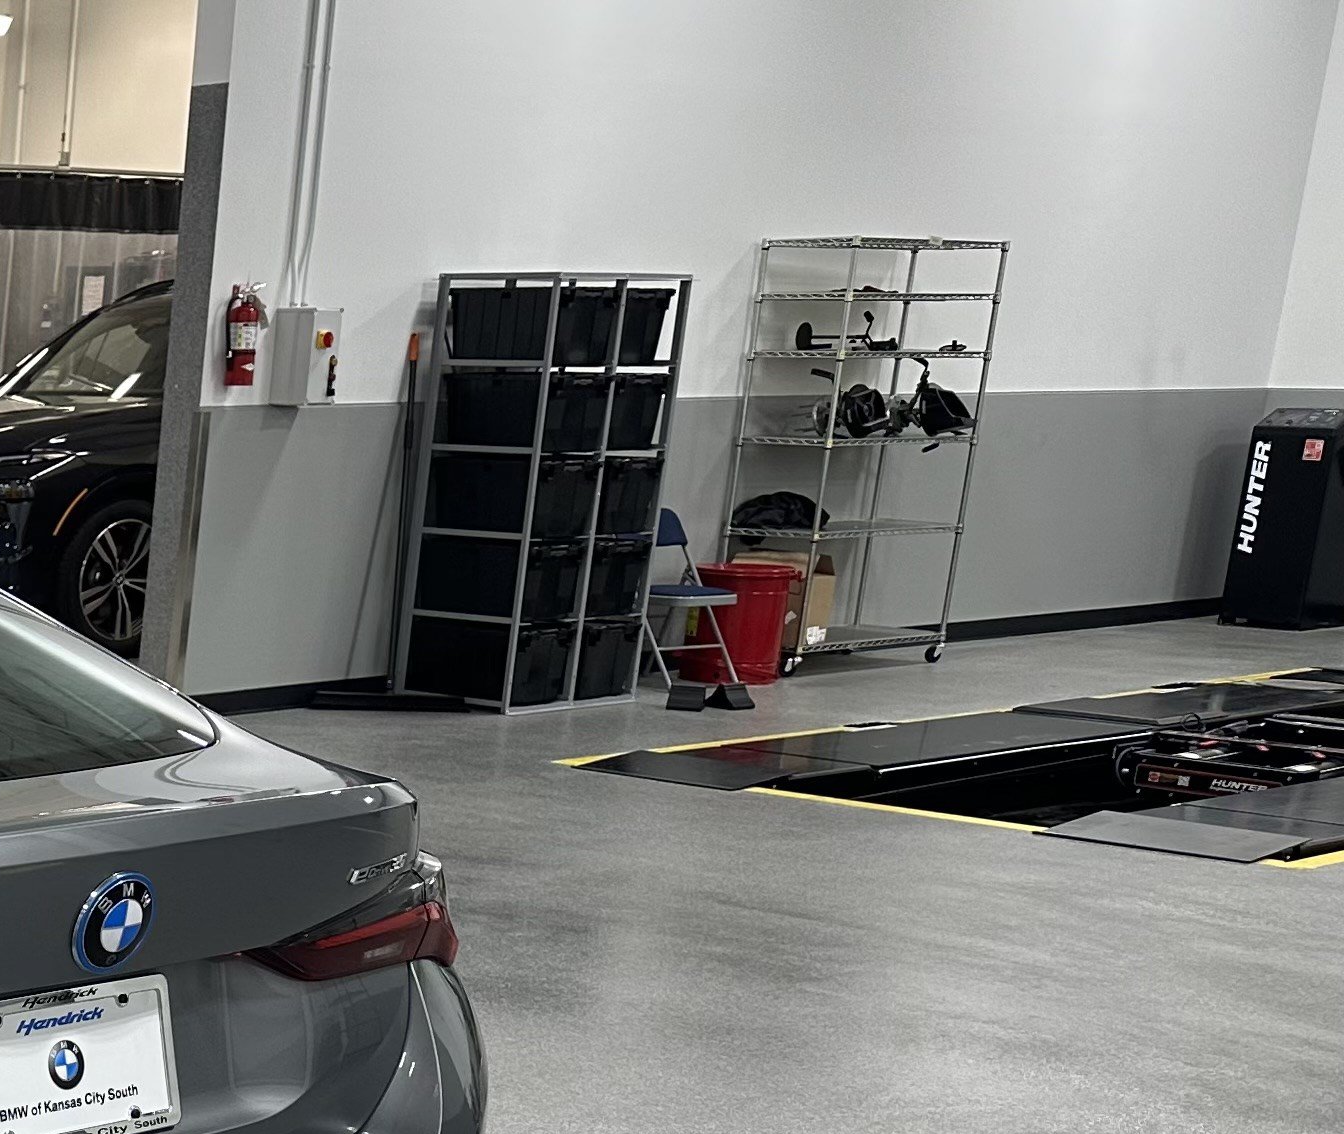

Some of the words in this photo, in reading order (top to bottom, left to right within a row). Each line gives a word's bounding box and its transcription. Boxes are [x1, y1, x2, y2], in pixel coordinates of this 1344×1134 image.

[1237, 440, 1272, 554] HUNTER
[22, 986, 98, 1010] Hendrick
[16, 1006, 104, 1036] Hendrick
[0, 1104, 29, 1122] BMW
[31, 1102, 43, 1115] of
[44, 1095, 82, 1113] Kansas
[85, 1091, 106, 1109] City
[108, 1084, 139, 1101] South
[134, 1115, 168, 1130] South
